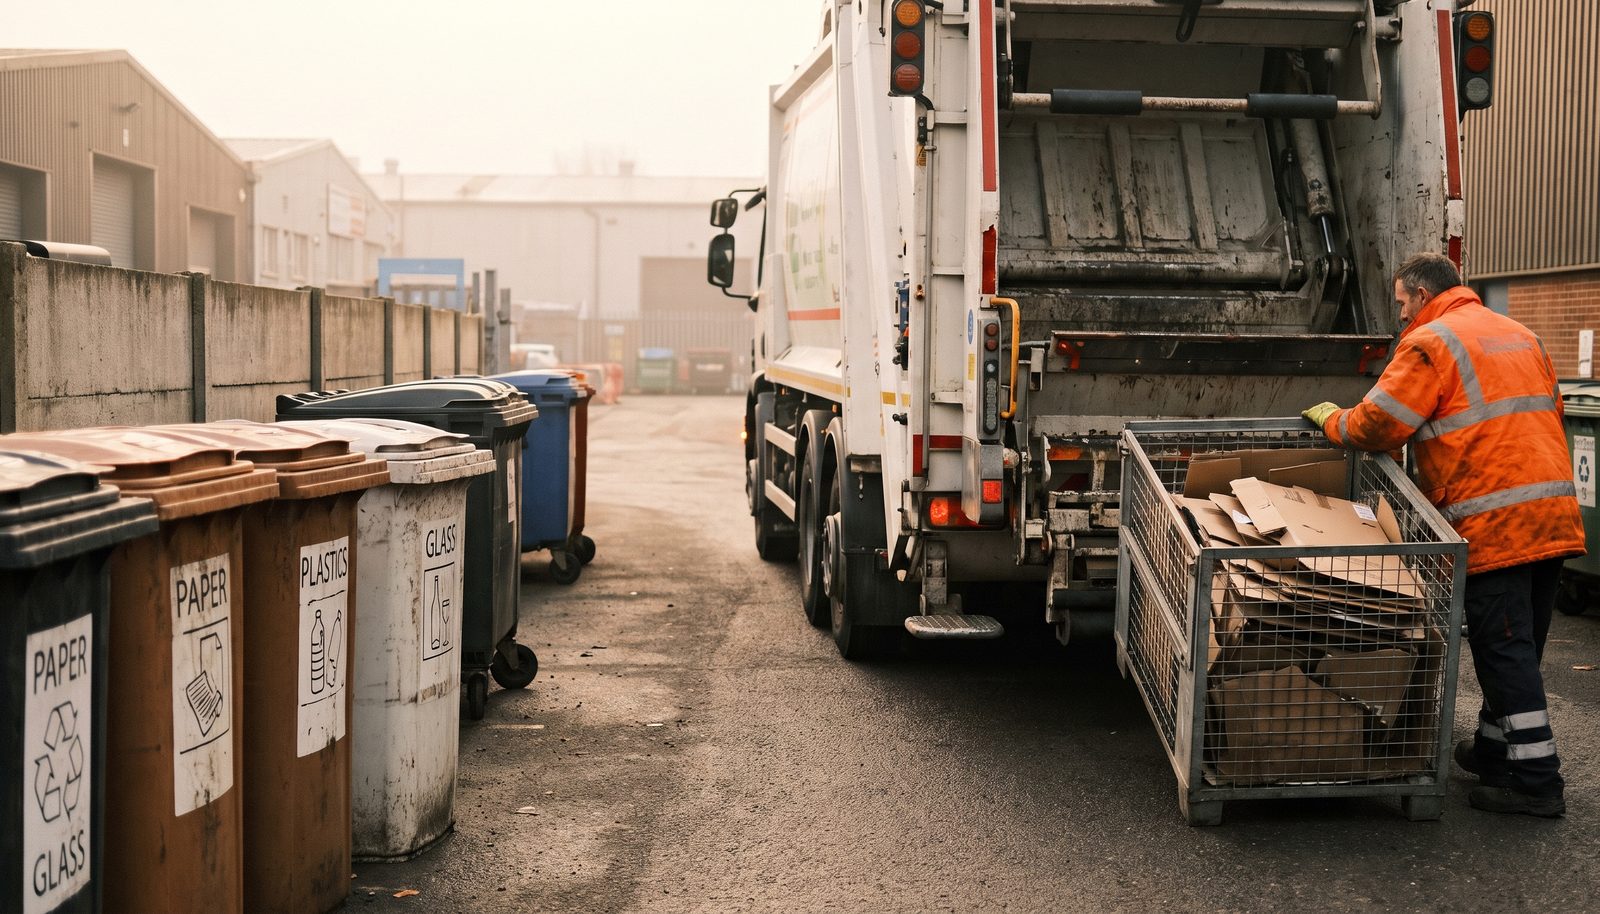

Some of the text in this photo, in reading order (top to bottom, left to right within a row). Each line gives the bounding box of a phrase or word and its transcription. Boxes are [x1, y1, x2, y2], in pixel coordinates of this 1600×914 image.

[425, 524, 457, 558] GLASS
[301, 547, 348, 588] PLASTICS
[176, 568, 228, 618] PAPER
[34, 634, 88, 695] PAPER
[33, 830, 86, 897] GLASS
